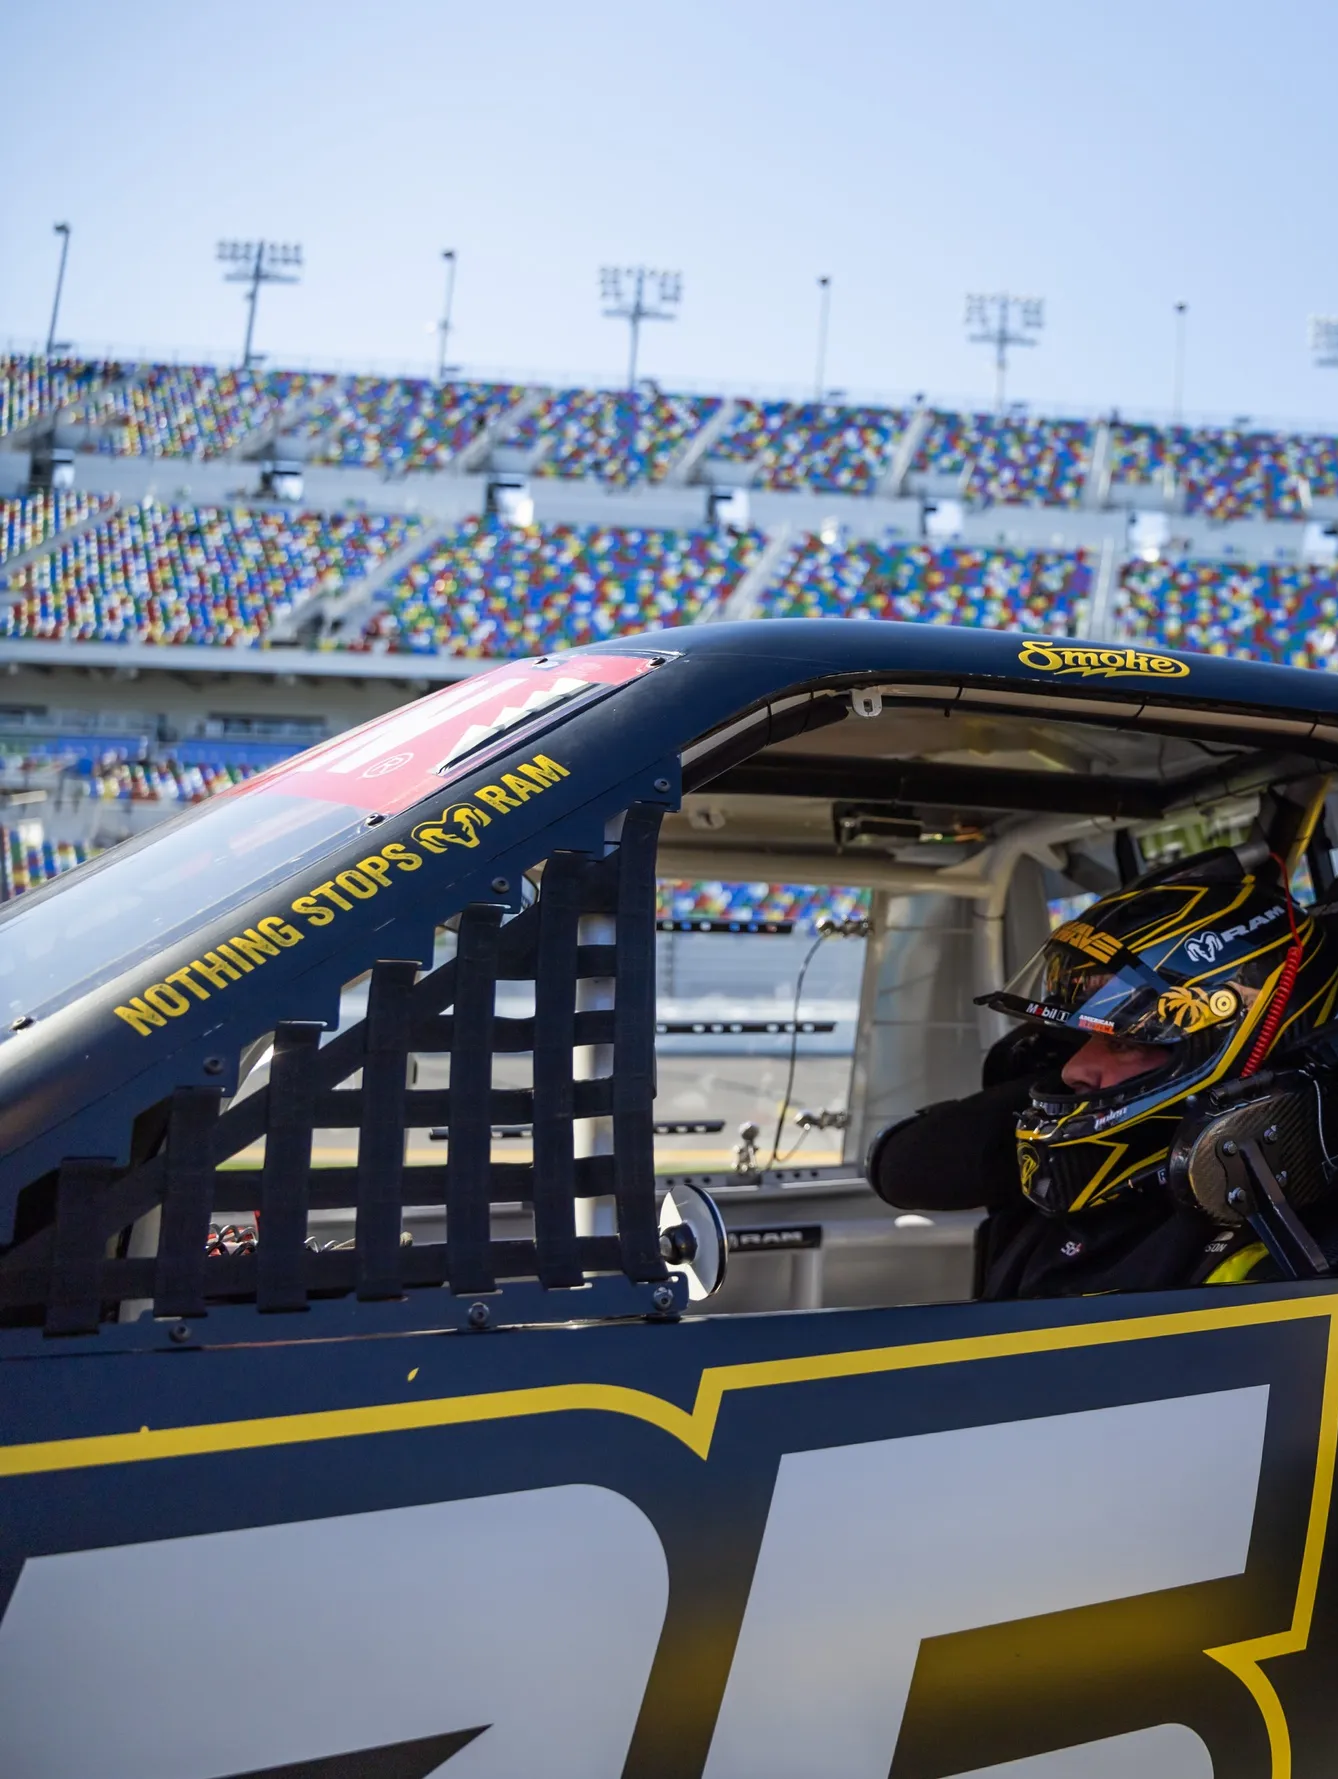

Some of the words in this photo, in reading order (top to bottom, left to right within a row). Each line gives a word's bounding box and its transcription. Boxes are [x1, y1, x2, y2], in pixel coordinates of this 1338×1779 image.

[1018, 641, 1191, 678] Smoke
[113, 916, 305, 1037] NOTHING
[292, 842, 423, 927] STOPS
[474, 753, 571, 815] RAM
[1220, 905, 1286, 943] RAM
